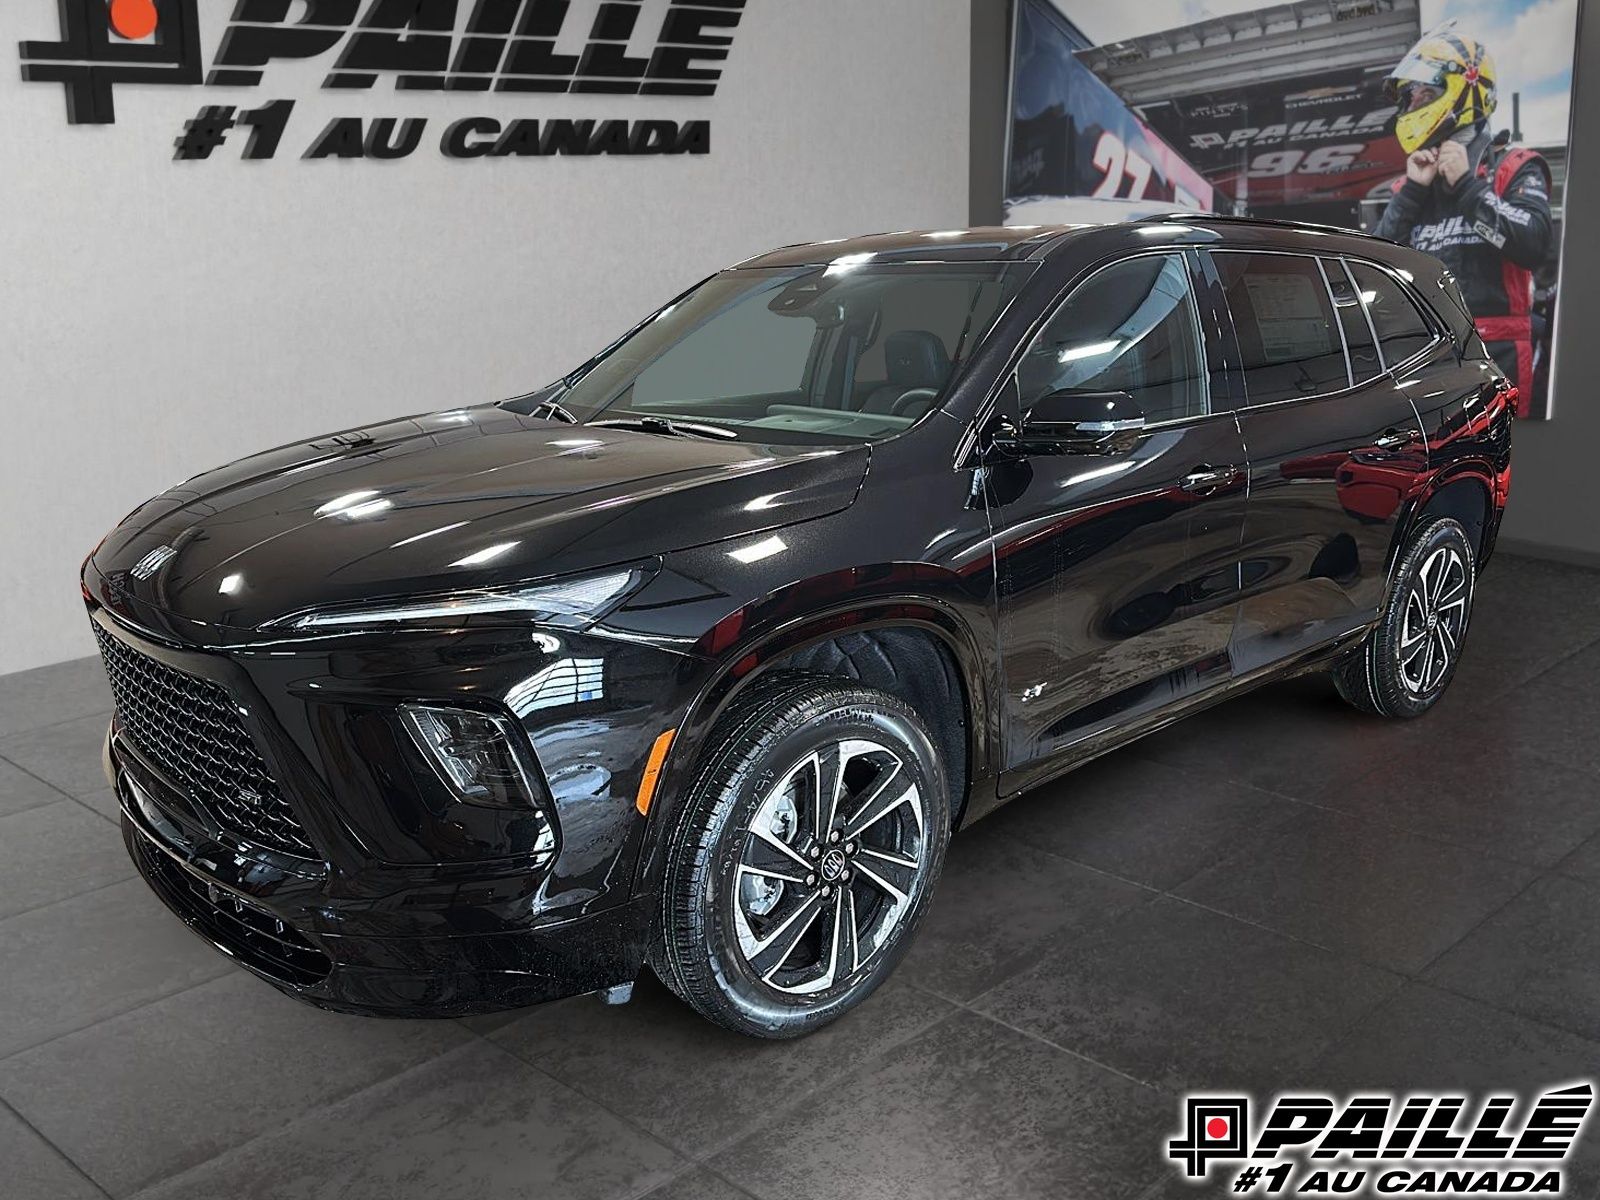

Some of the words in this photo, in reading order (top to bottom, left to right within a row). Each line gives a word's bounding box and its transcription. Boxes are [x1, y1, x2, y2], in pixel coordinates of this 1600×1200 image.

[172, 99, 296, 160] #1
[300, 117, 428, 160] AU
[440, 117, 710, 158] CANADA
[1289, 126, 1384, 142] CANADA
[1248, 143, 1365, 179] 96
